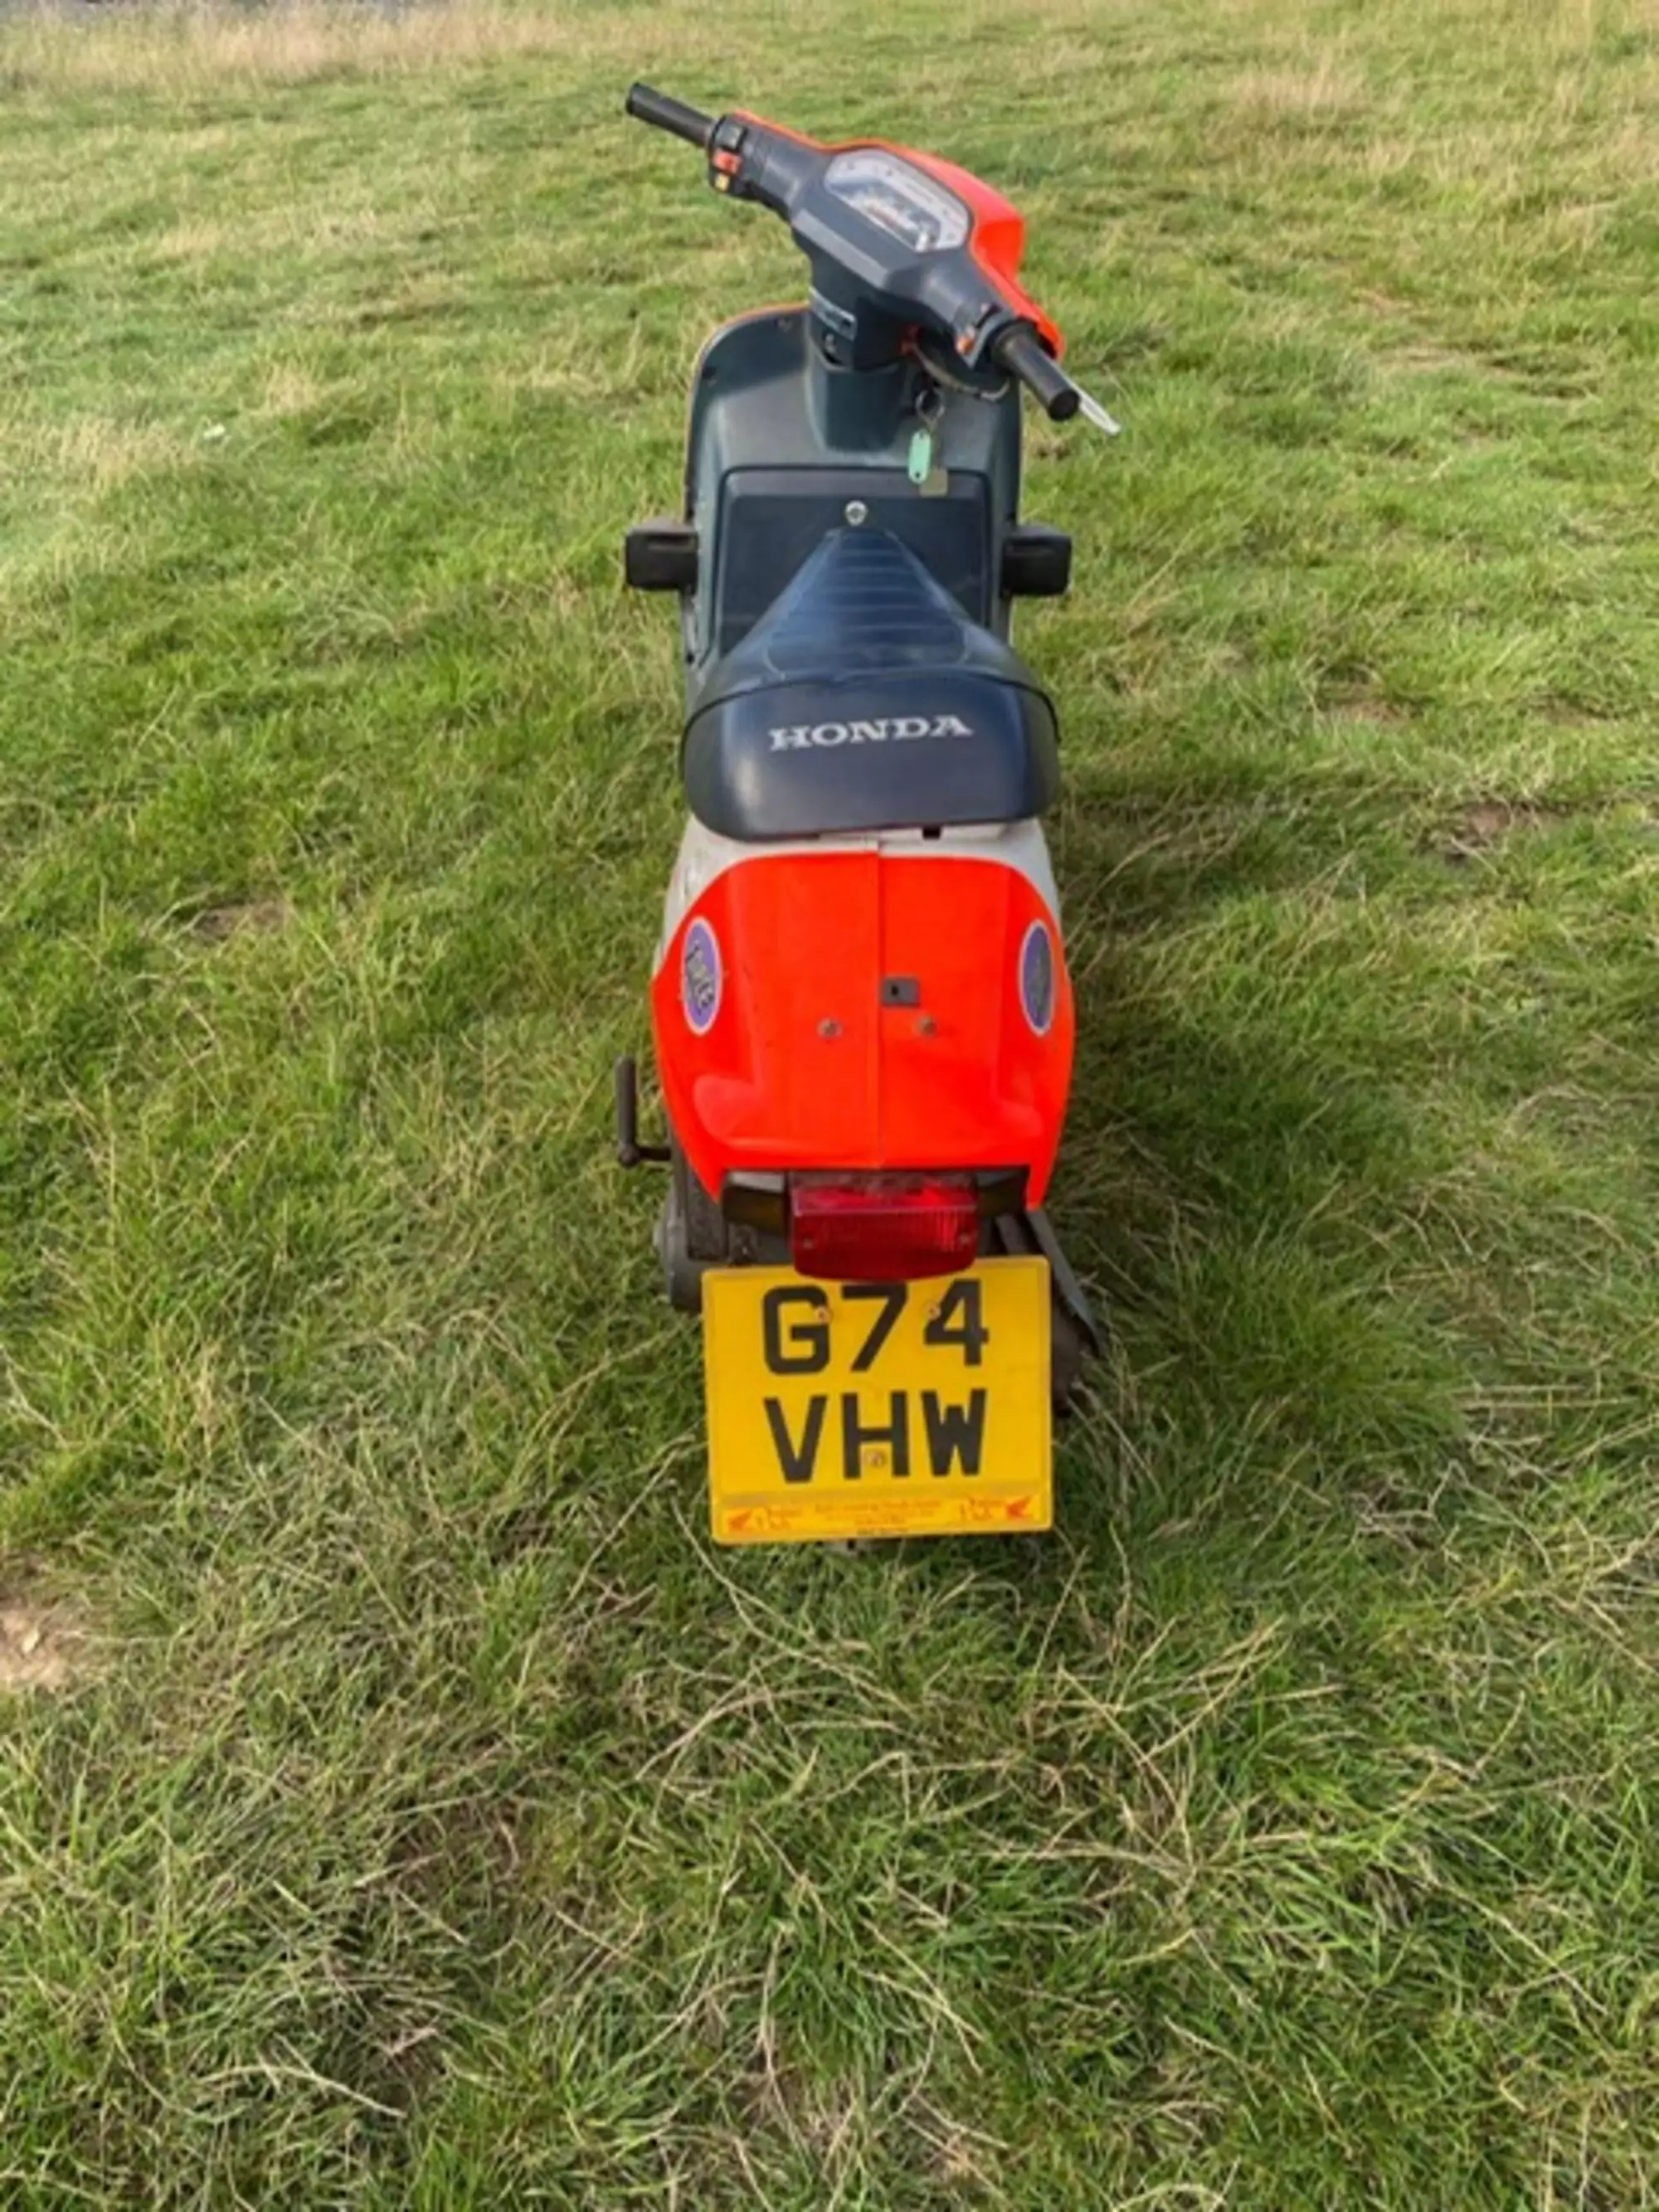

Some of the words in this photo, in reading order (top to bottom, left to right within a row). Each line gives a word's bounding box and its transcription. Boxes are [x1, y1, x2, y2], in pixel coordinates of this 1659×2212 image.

[769, 714, 974, 751] HONDA
[762, 1279, 989, 1374] G74
[763, 1388, 987, 1484] VHW
